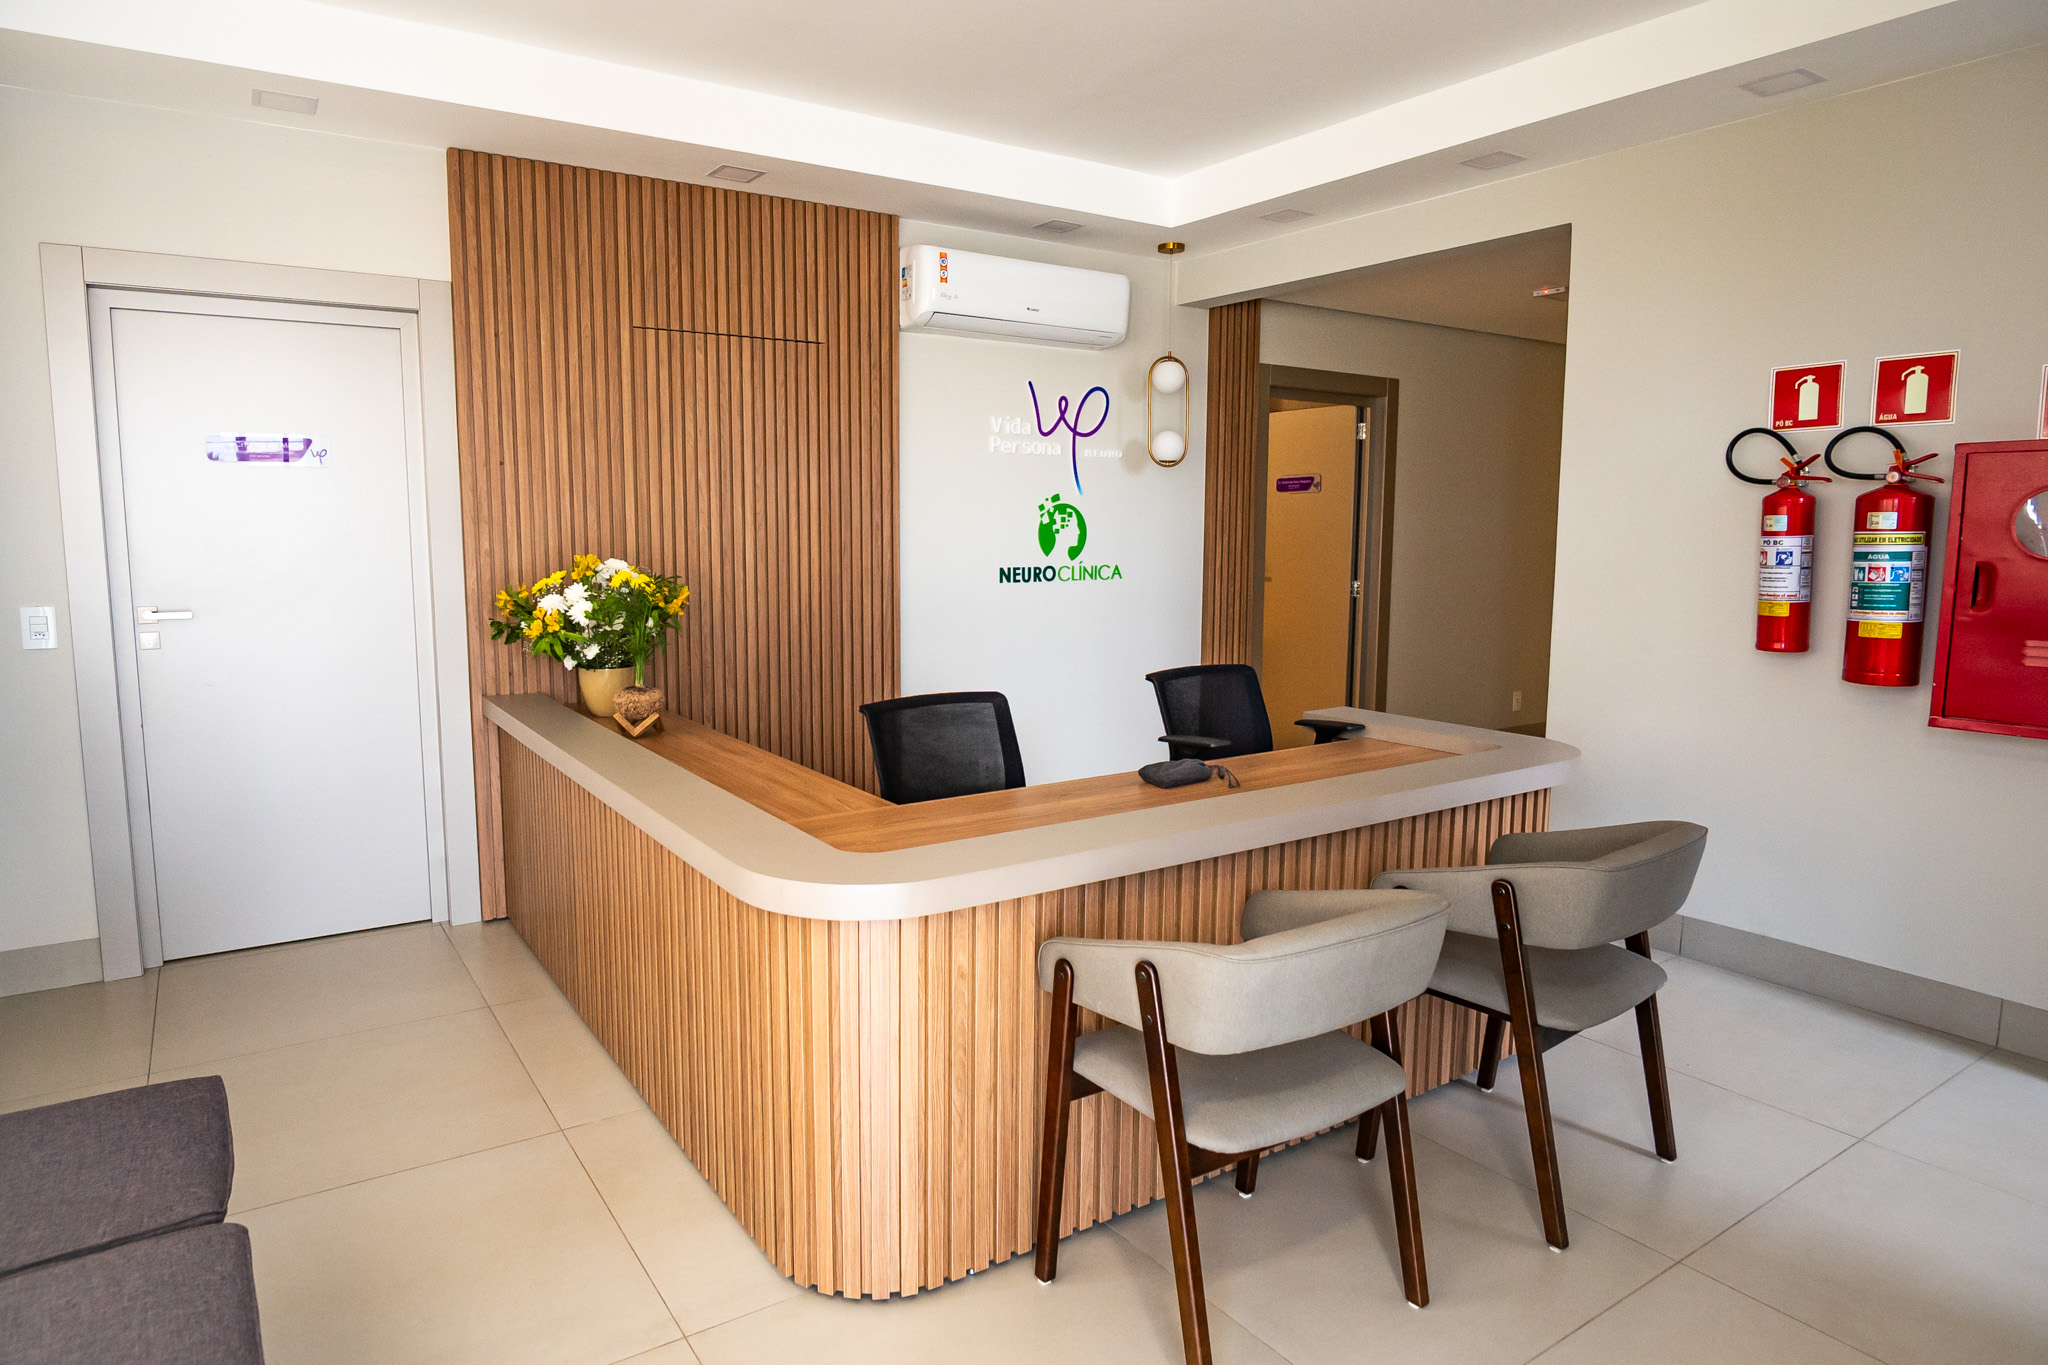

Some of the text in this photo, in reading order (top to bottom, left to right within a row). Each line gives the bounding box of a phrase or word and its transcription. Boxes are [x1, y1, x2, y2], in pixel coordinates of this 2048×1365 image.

[1879, 413, 1897, 421] ÁGUA
[990, 416, 1032, 435] Vida
[1775, 419, 1784, 427] PÓ
[989, 436, 1061, 456] Persona
[1084, 449, 1123, 459] NEURO
[1888, 535, 1922, 543] ELETRICIDADE
[999, 560, 1122, 584] NEUROCLÍNICA
